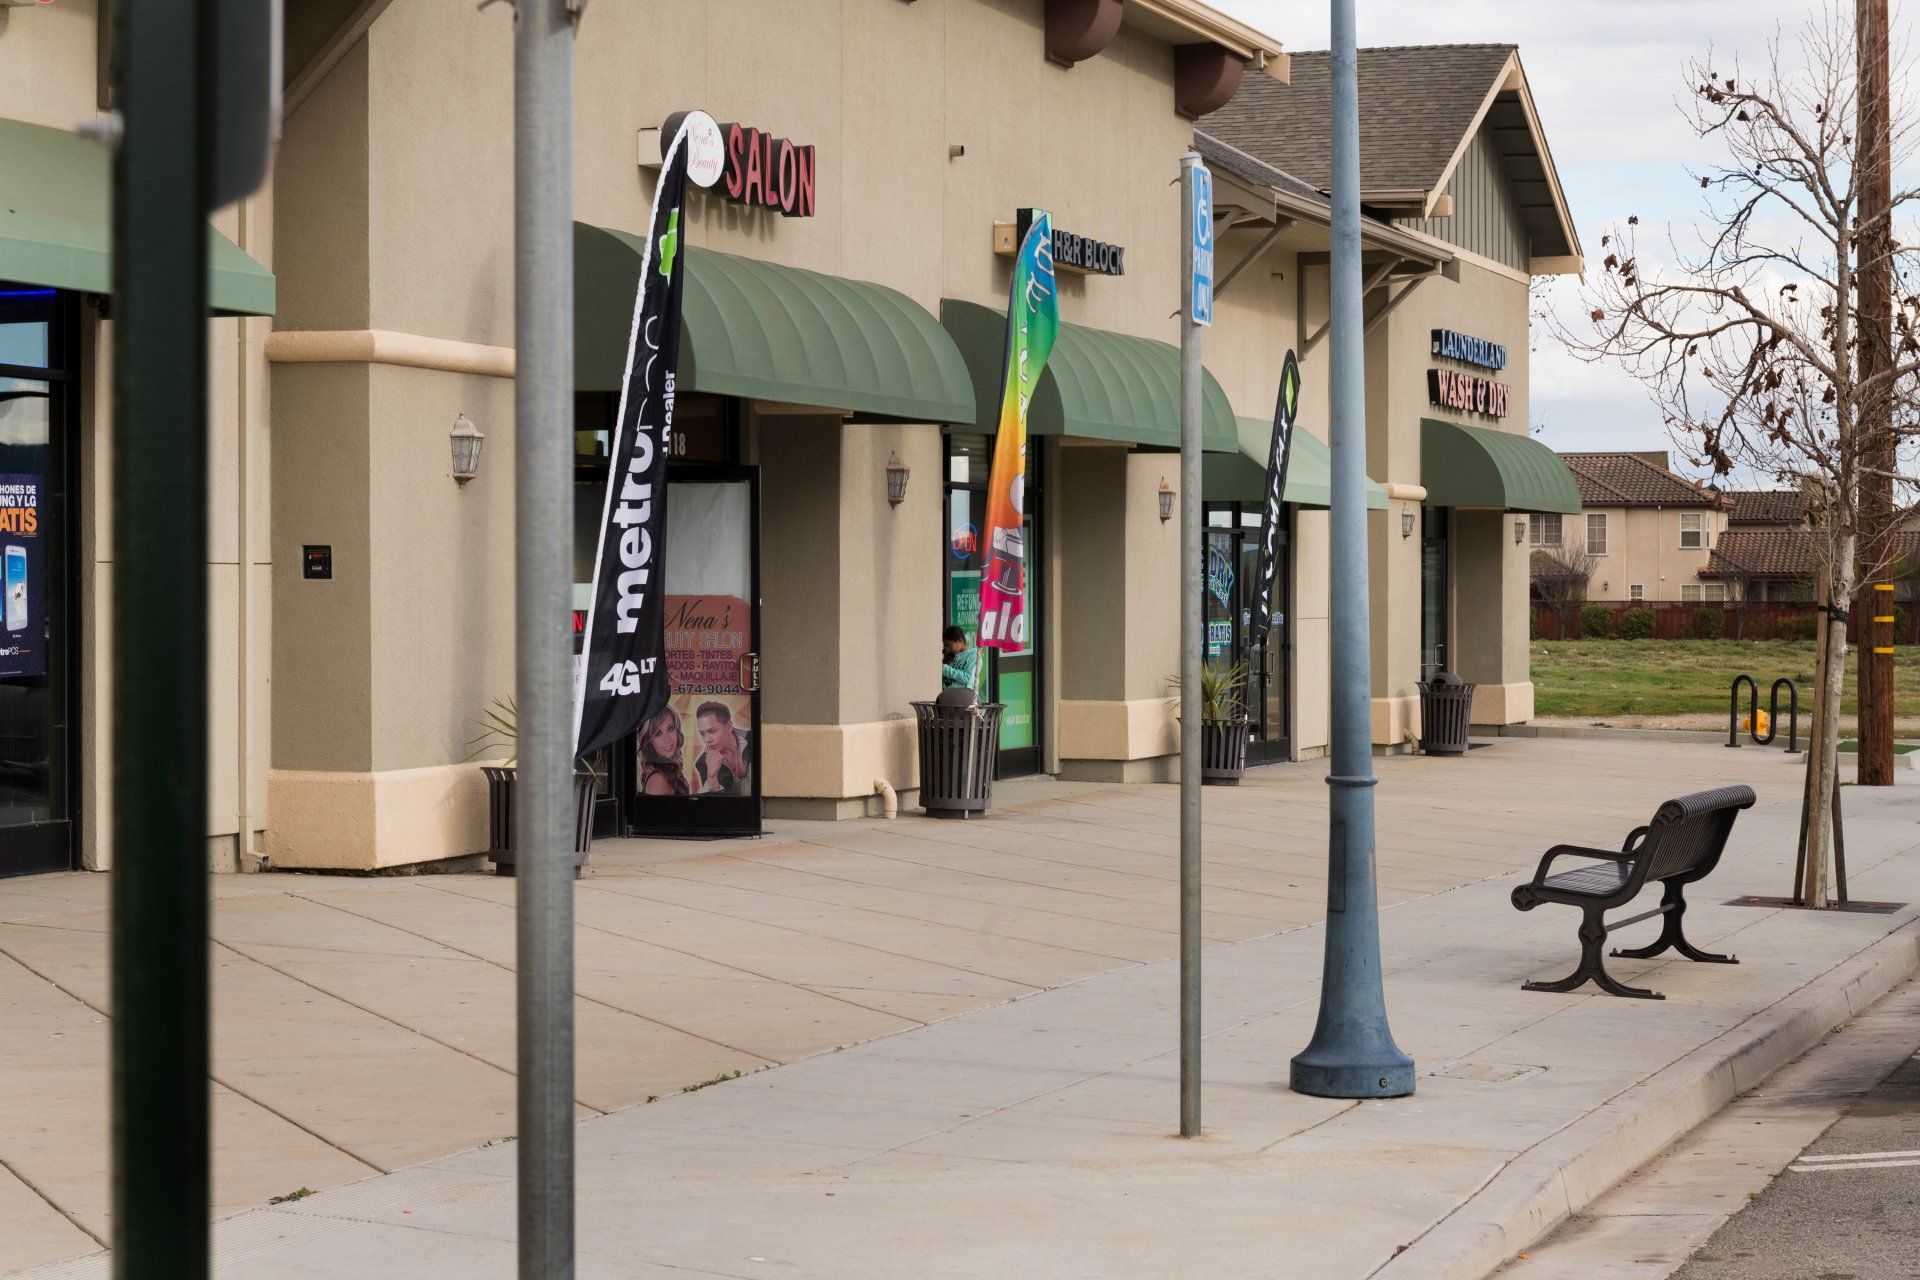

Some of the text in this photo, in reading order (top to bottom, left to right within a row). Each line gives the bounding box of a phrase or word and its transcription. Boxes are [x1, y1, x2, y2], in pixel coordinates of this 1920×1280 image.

[689, 145, 718, 180] Beauty
[726, 122, 815, 218] SALON
[1053, 230, 1125, 275] H&R BLOCK
[1441, 328, 1507, 370] LAUNDERLAND
[1438, 368, 1473, 410] WASH
[1489, 380, 1511, 417] DRY
[16, 495, 24, 507] Y
[24, 495, 37, 507] LG
[26, 485, 37, 495] DE
[952, 528, 978, 552] OPEN
[957, 593, 981, 611] REFUN
[699, 631, 743, 649] SALON
[680, 671, 738, 682] MAQUILLAJE
[752, 658, 760, 688] PULL
